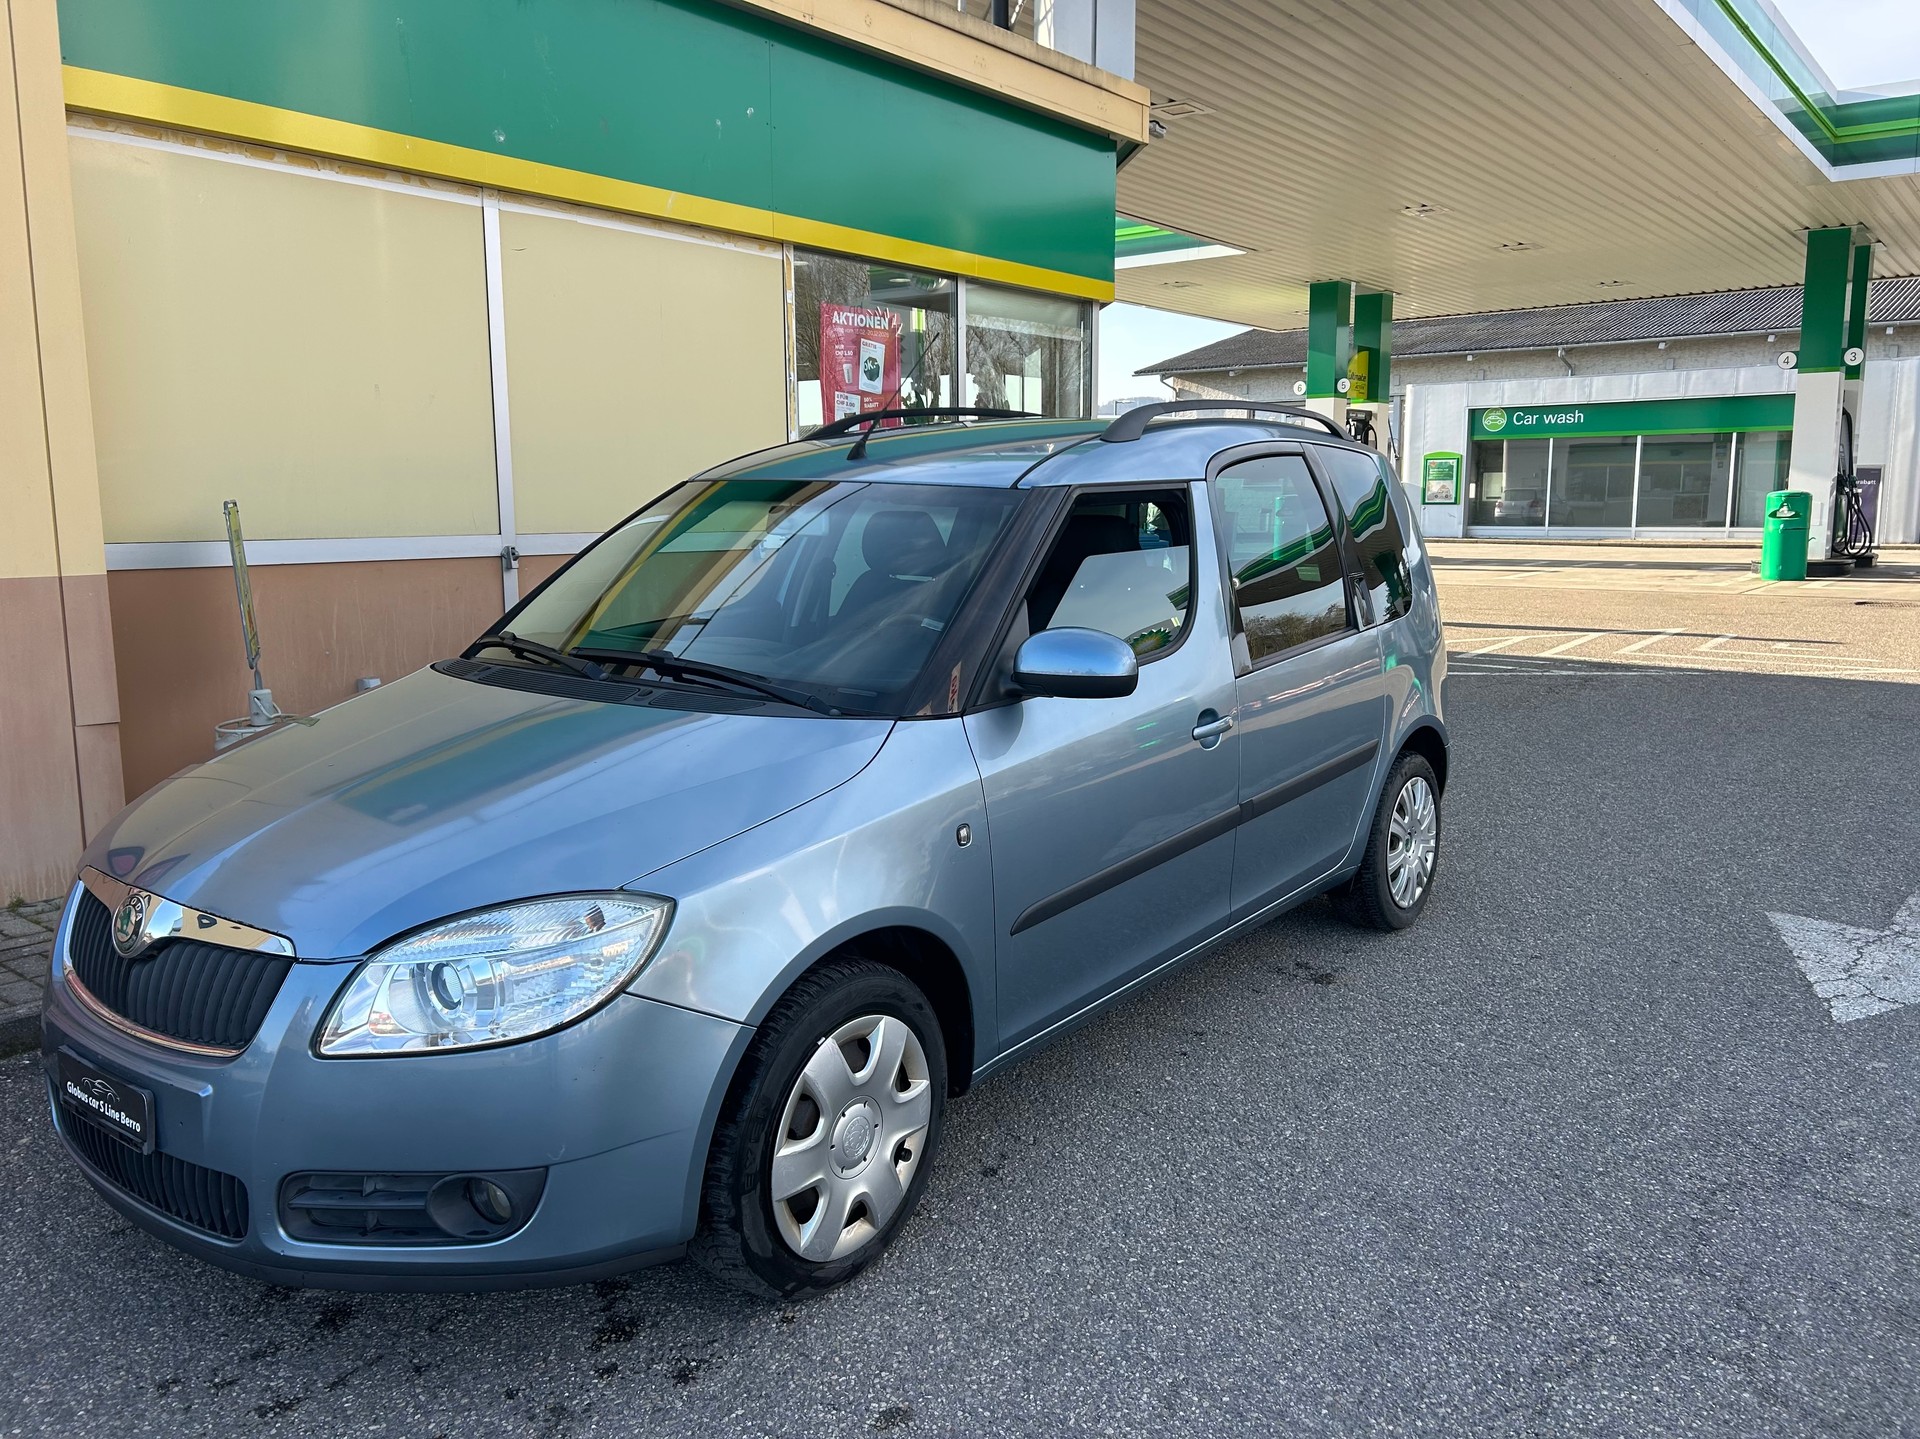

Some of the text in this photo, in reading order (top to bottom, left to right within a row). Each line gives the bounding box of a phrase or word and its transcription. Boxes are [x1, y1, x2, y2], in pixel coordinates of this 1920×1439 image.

[832, 310, 889, 330] AKTIONEN
[1782, 356, 1790, 366] 4
[1849, 352, 1857, 362] 3
[1297, 384, 1303, 393] 6
[1341, 381, 1347, 390] 5
[1513, 409, 1584, 426] Car wash
[66, 1080, 141, 1133] Globus car S Line Berro
